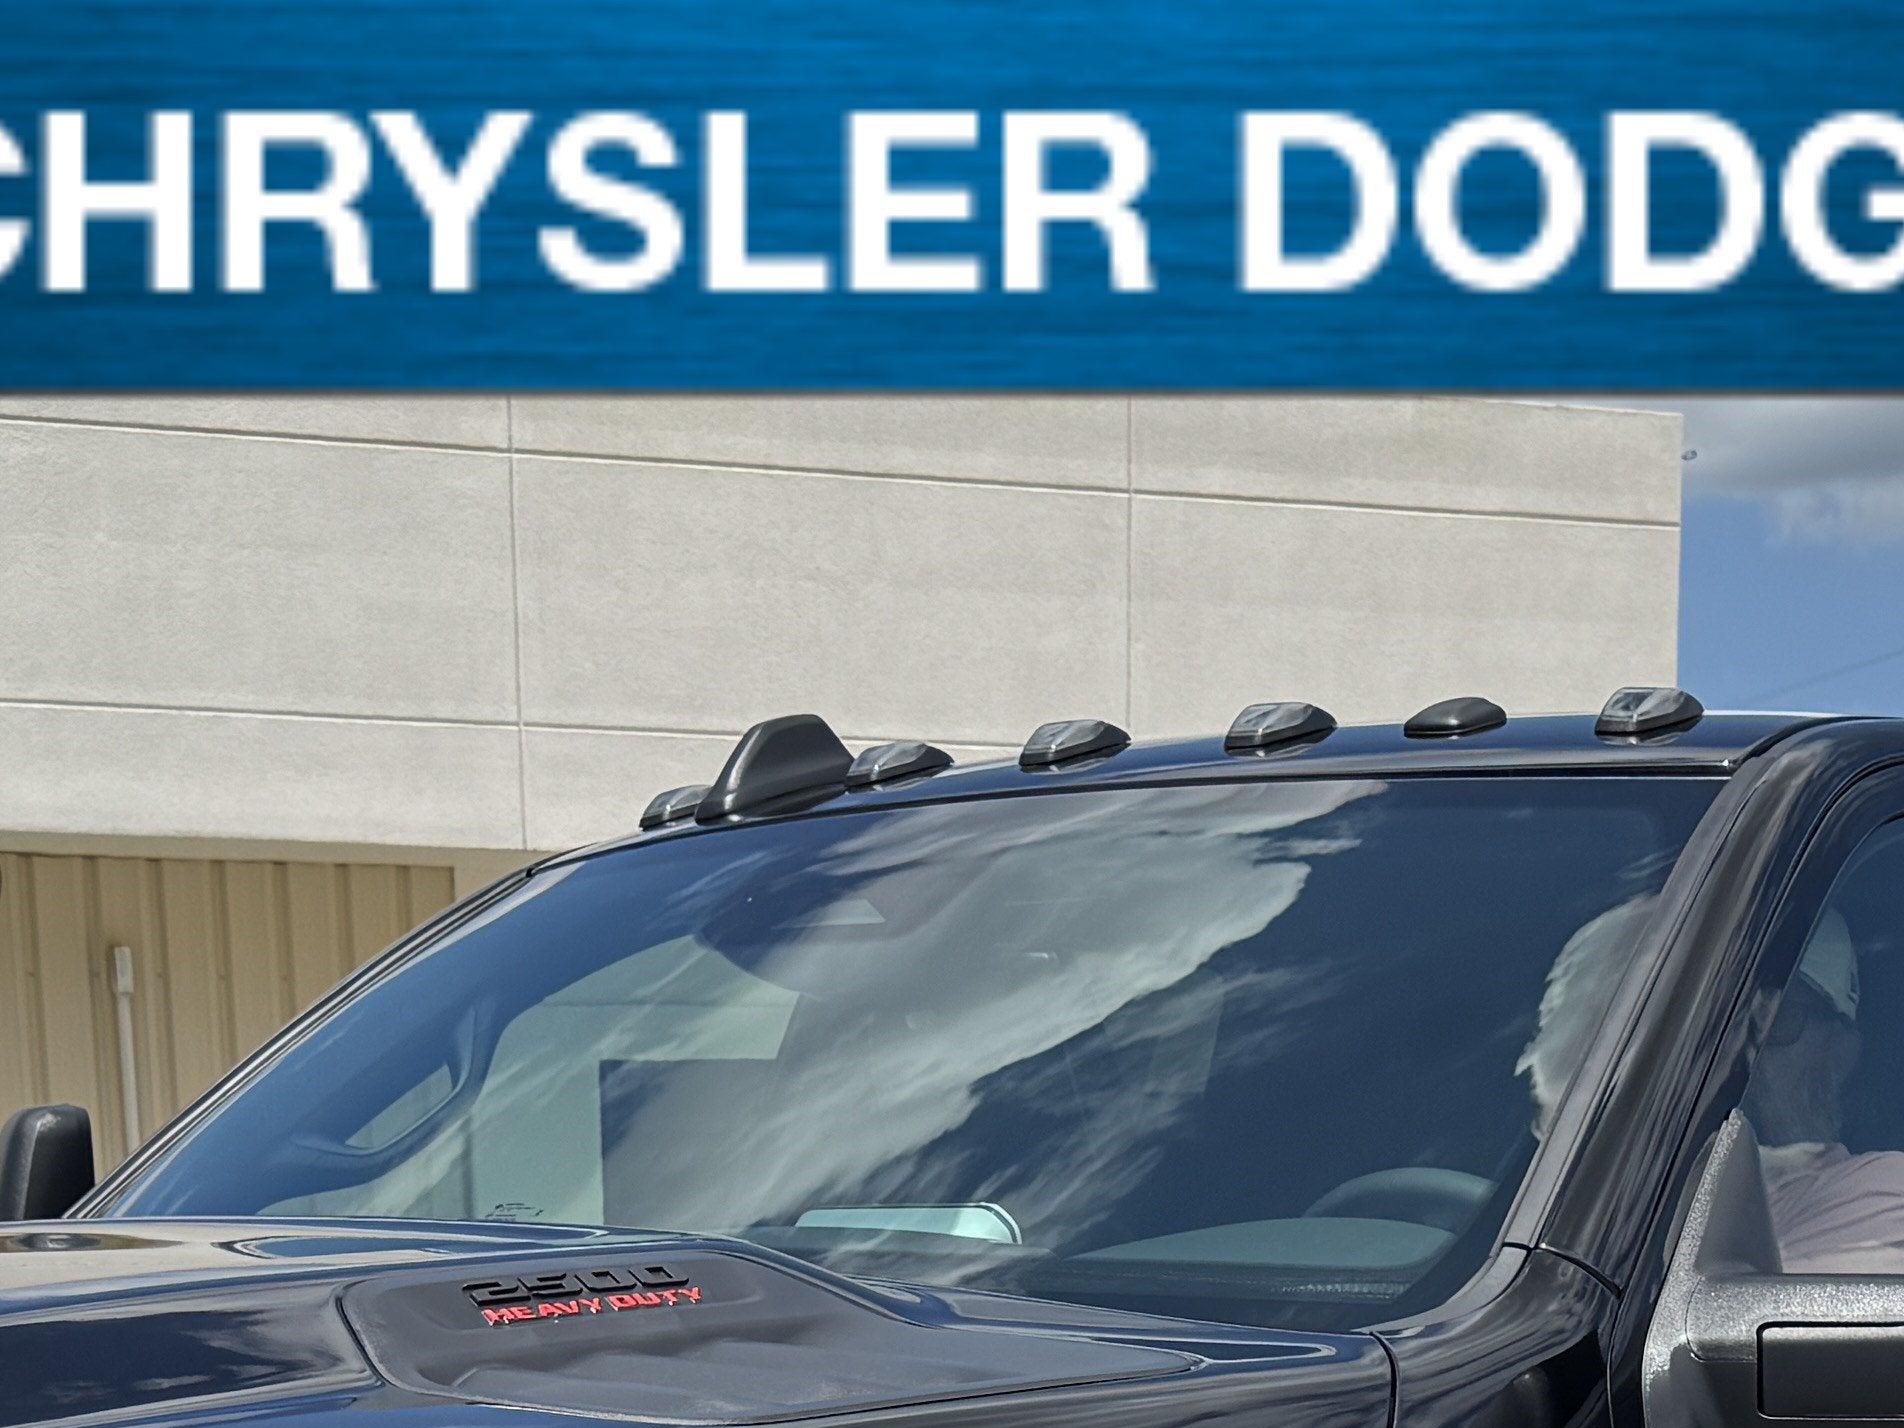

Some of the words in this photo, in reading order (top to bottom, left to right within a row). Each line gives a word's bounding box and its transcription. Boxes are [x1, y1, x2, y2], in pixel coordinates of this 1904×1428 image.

[462, 1264, 690, 1307] 2500
[482, 1296, 602, 1327] HEAVY
[606, 1286, 704, 1312] DUTY
